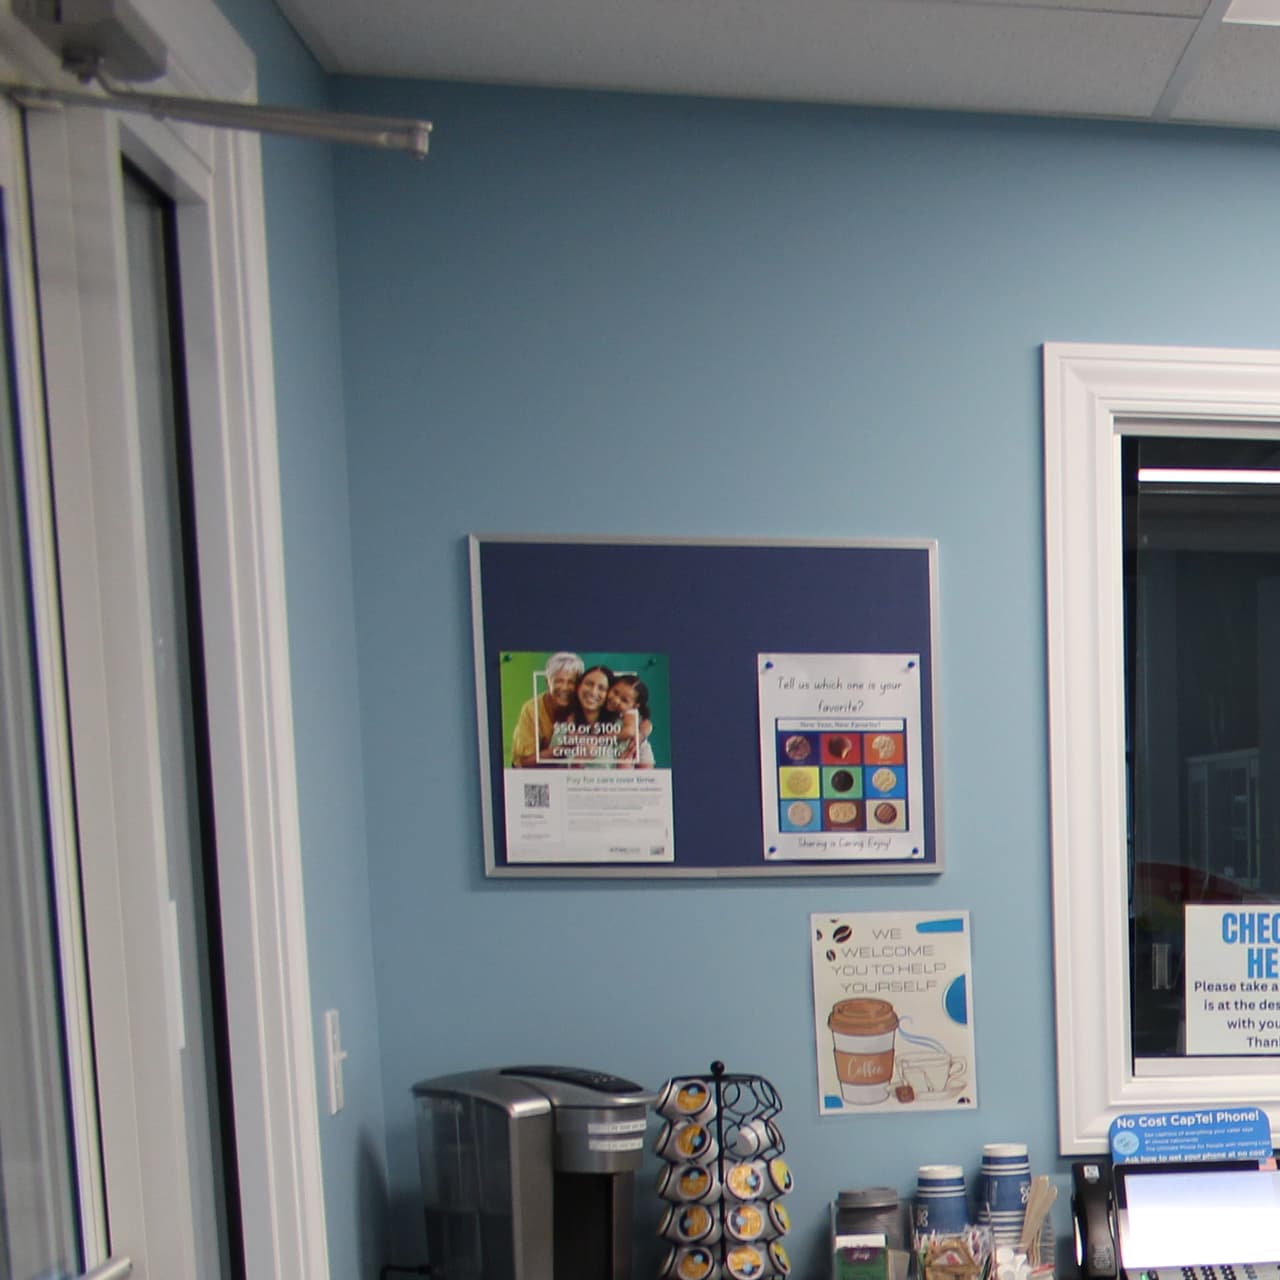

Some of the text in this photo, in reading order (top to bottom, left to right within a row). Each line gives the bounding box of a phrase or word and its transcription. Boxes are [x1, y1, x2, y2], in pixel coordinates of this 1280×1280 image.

[778, 676, 902, 695] Tell us which one is your
[817, 700, 864, 713] favorite?
[553, 721, 622, 735] $50 or $100
[556, 735, 618, 746] statement
[553, 746, 586, 757] credit
[872, 928, 903, 940] WE
[841, 945, 936, 959] WELCOME
[831, 962, 946, 977] YOU TO HELP
[841, 980, 938, 994] YOURSELF
[1194, 981, 1236, 993] Please
[1240, 981, 1268, 992] take
[1271, 983, 1279, 992] a
[1204, 1000, 1214, 1010] is
[1217, 1000, 1230, 1010] at
[1234, 1000, 1255, 1010] the
[1227, 1017, 1255, 1029] with
[847, 1055, 884, 1078] Coffee
[1117, 1109, 1259, 1129] No Cost CapTel Phone!
[1125, 1155, 1139, 1163] Ask
[1141, 1154, 1157, 1162] how
[1158, 1154, 1167, 1162] to
[1183, 1153, 1201, 1162] your
[1202, 1151, 1227, 1161] phone
[1237, 1150, 1248, 1158] no
[1249, 1149, 1265, 1157] cost
